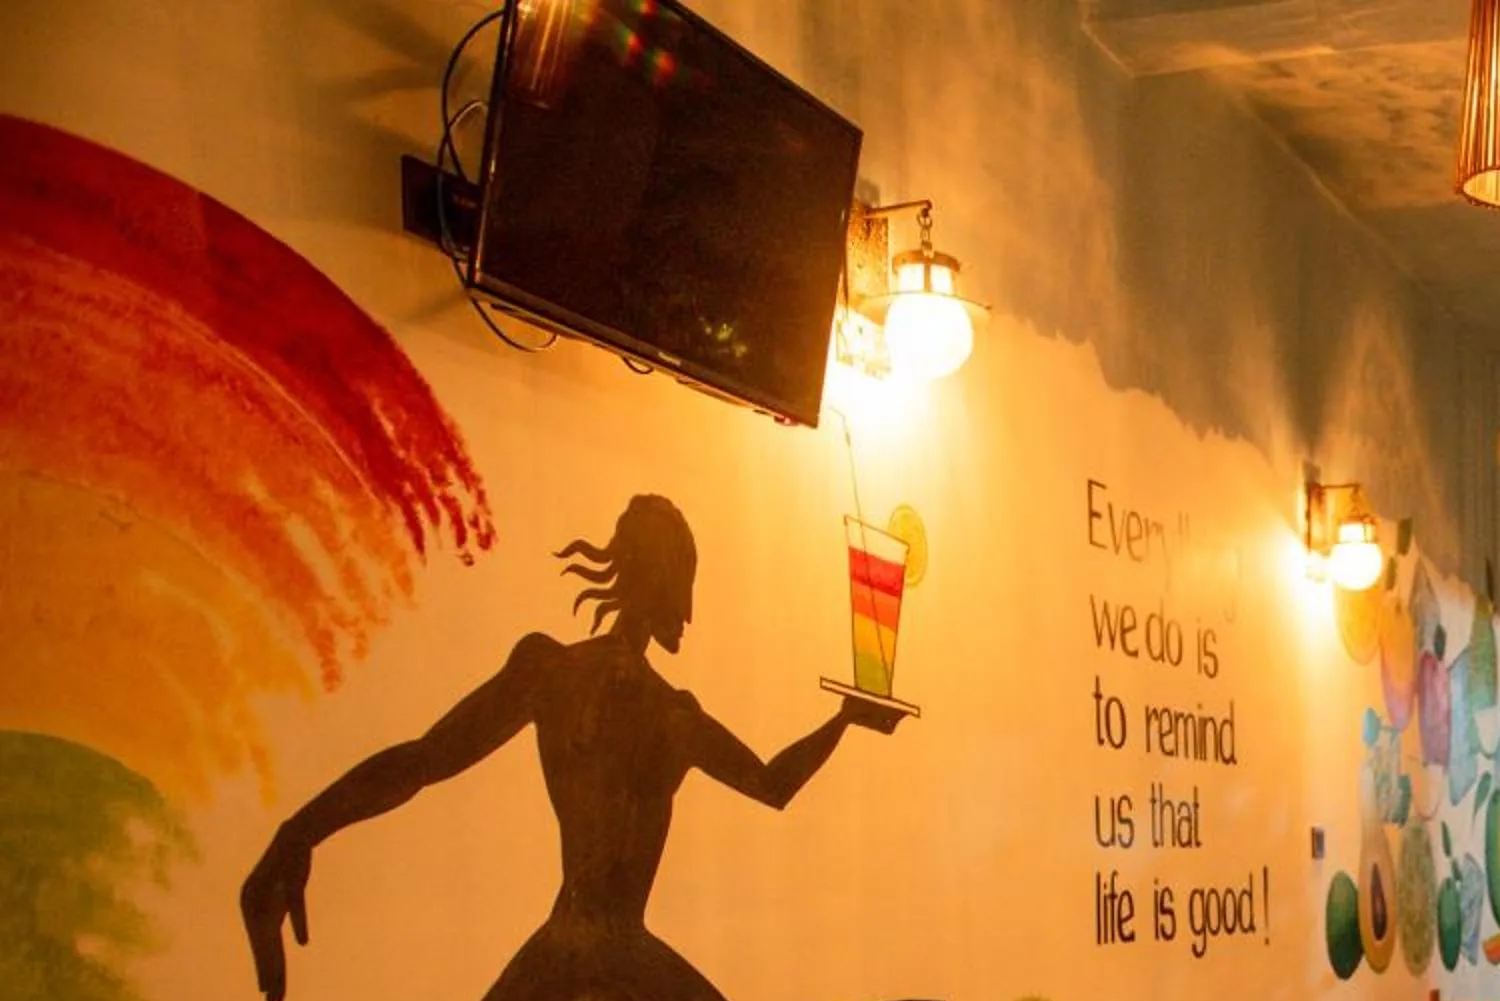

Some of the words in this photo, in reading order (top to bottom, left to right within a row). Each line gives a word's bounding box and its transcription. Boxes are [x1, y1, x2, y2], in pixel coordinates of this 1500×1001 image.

[1089, 593, 1139, 660] we
[1145, 598, 1184, 668] do
[1197, 616, 1220, 680] is
[1092, 674, 1127, 750] to
[1144, 700, 1238, 766] remind
[1094, 794, 1135, 850] us
[1149, 782, 1202, 850] that
[1095, 870, 1136, 946] life
[1153, 876, 1177, 942] is
[1189, 865, 1270, 959] good!
